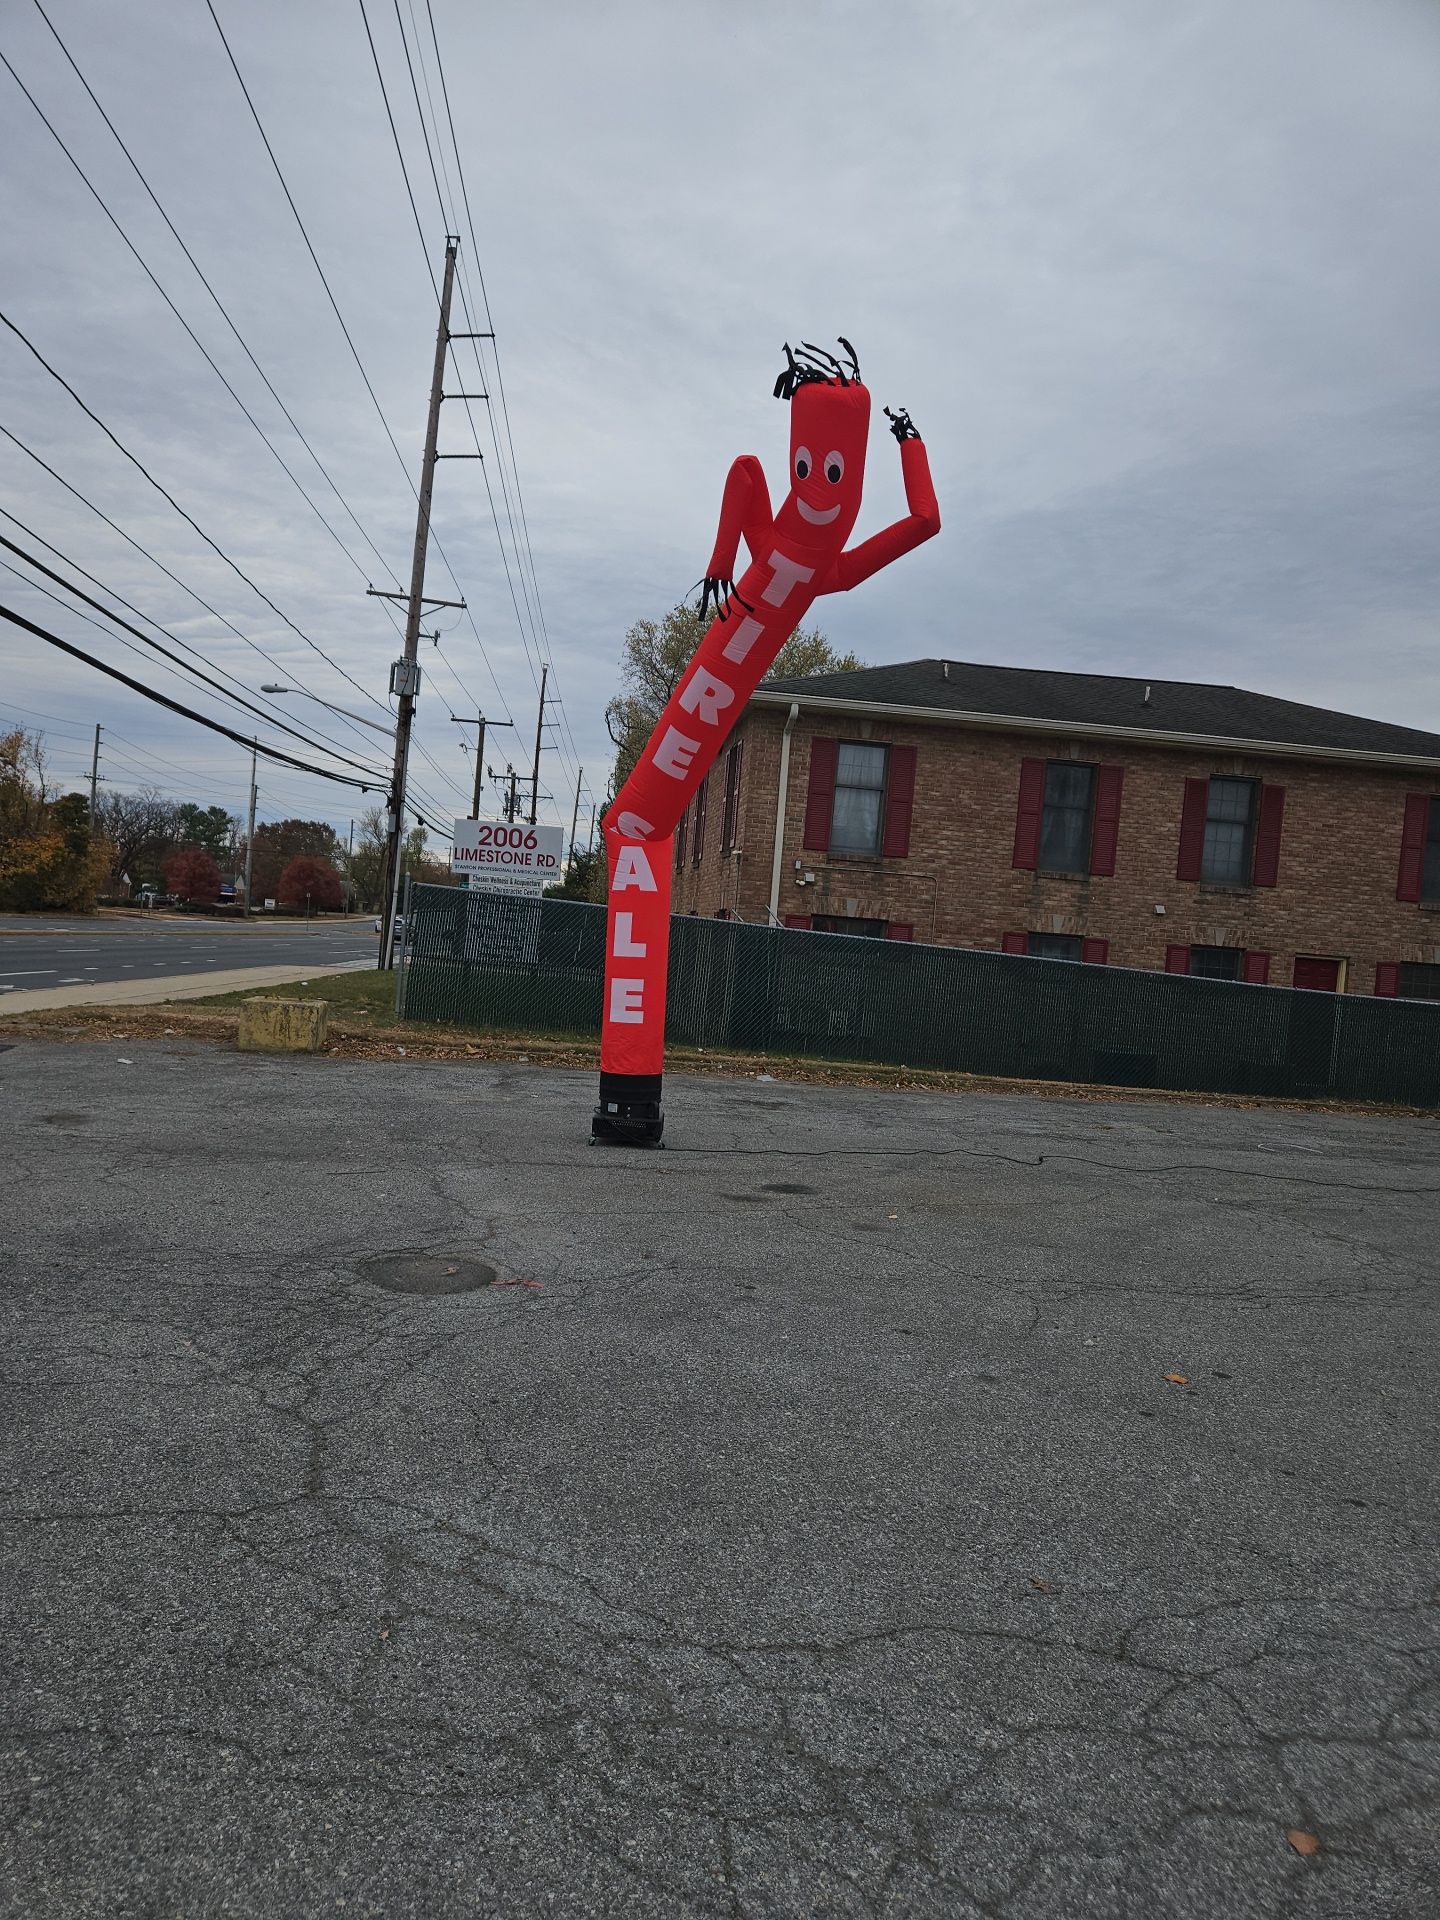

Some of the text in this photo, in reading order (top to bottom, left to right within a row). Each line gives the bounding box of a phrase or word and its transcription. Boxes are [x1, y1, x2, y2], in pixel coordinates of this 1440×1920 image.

[652, 549, 815, 781] TIRE
[478, 825, 538, 850] 2006
[454, 847, 559, 868] LIMESTONE RD.
[477, 865, 512, 873] PROFESSIONAL
[523, 888, 540, 896] Center
